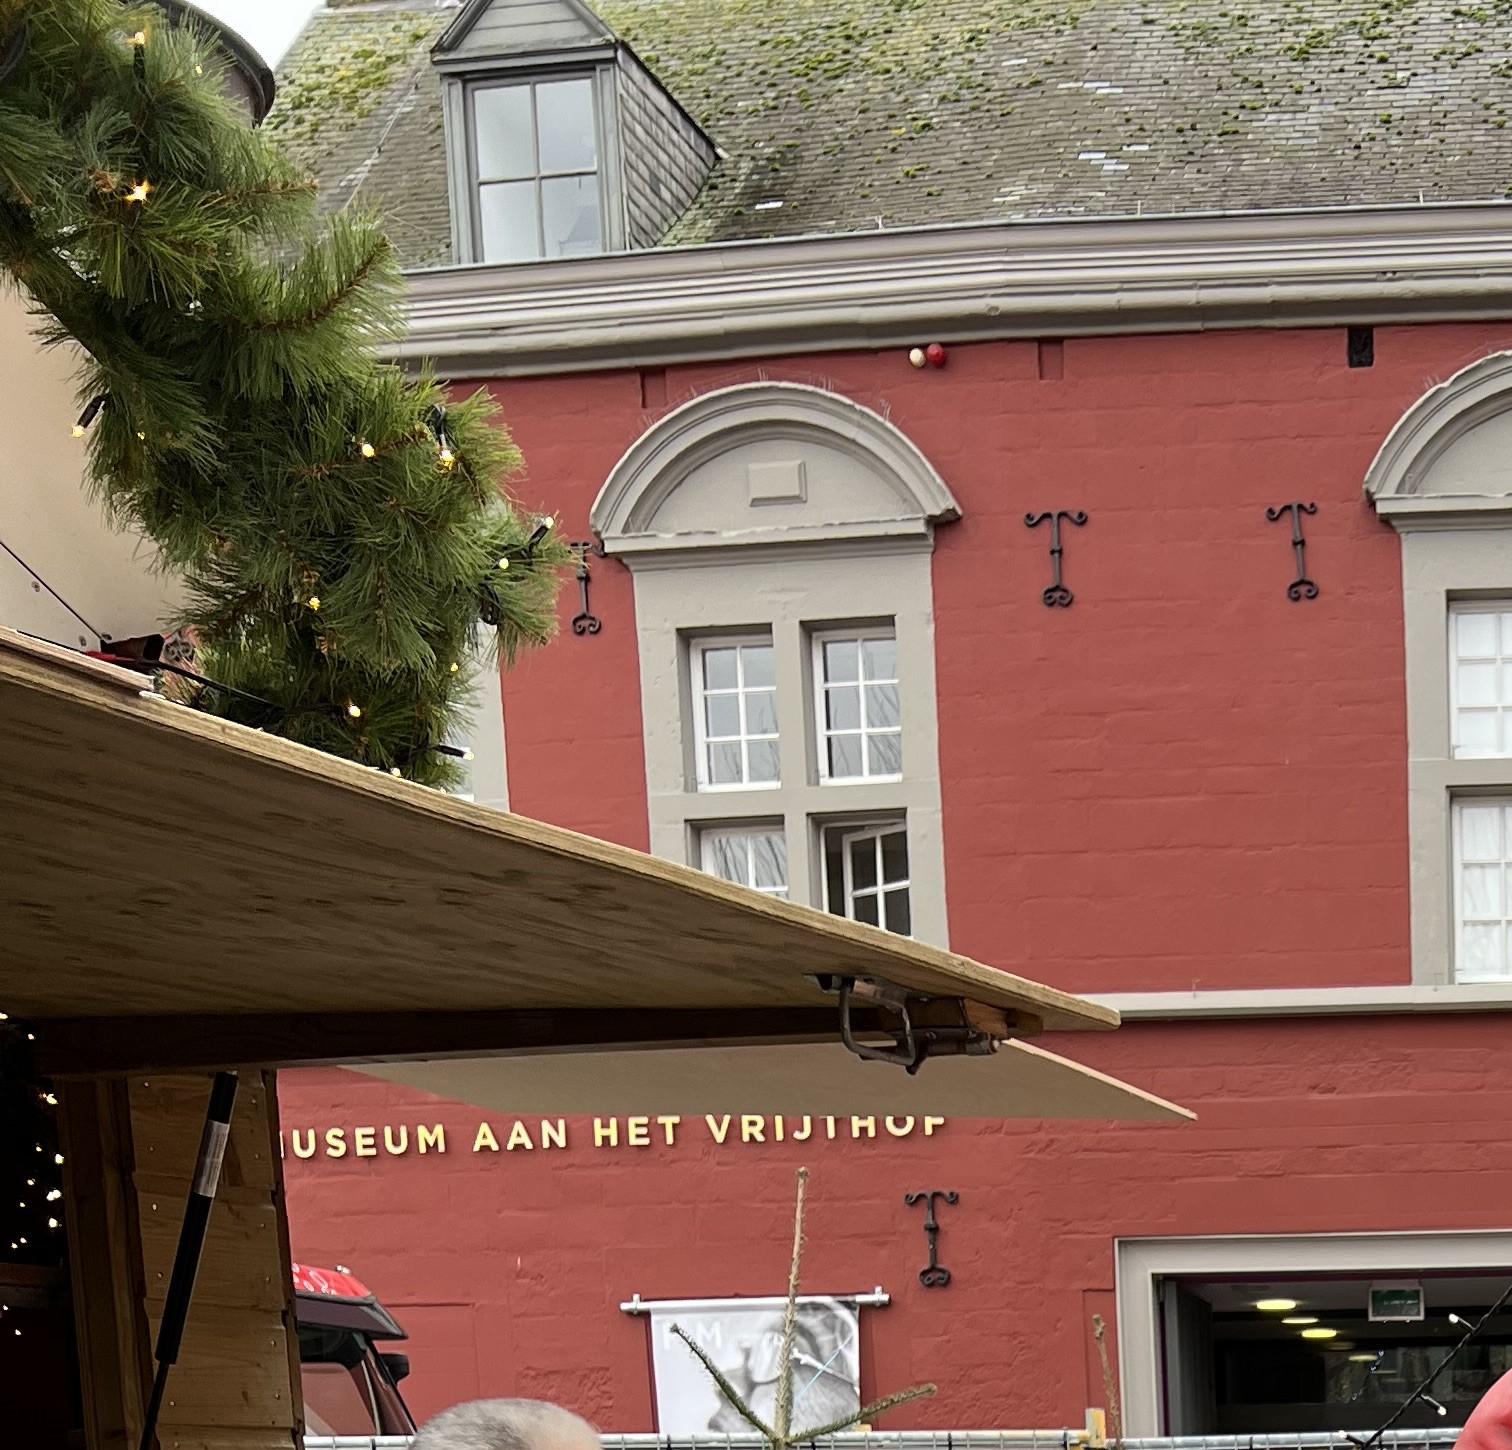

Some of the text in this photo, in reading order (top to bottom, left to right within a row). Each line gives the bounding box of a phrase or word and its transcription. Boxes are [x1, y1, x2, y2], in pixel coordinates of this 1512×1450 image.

[280, 1122, 446, 1158] USEUM
[472, 1118, 568, 1152] AAN
[593, 1115, 682, 1146] HET
